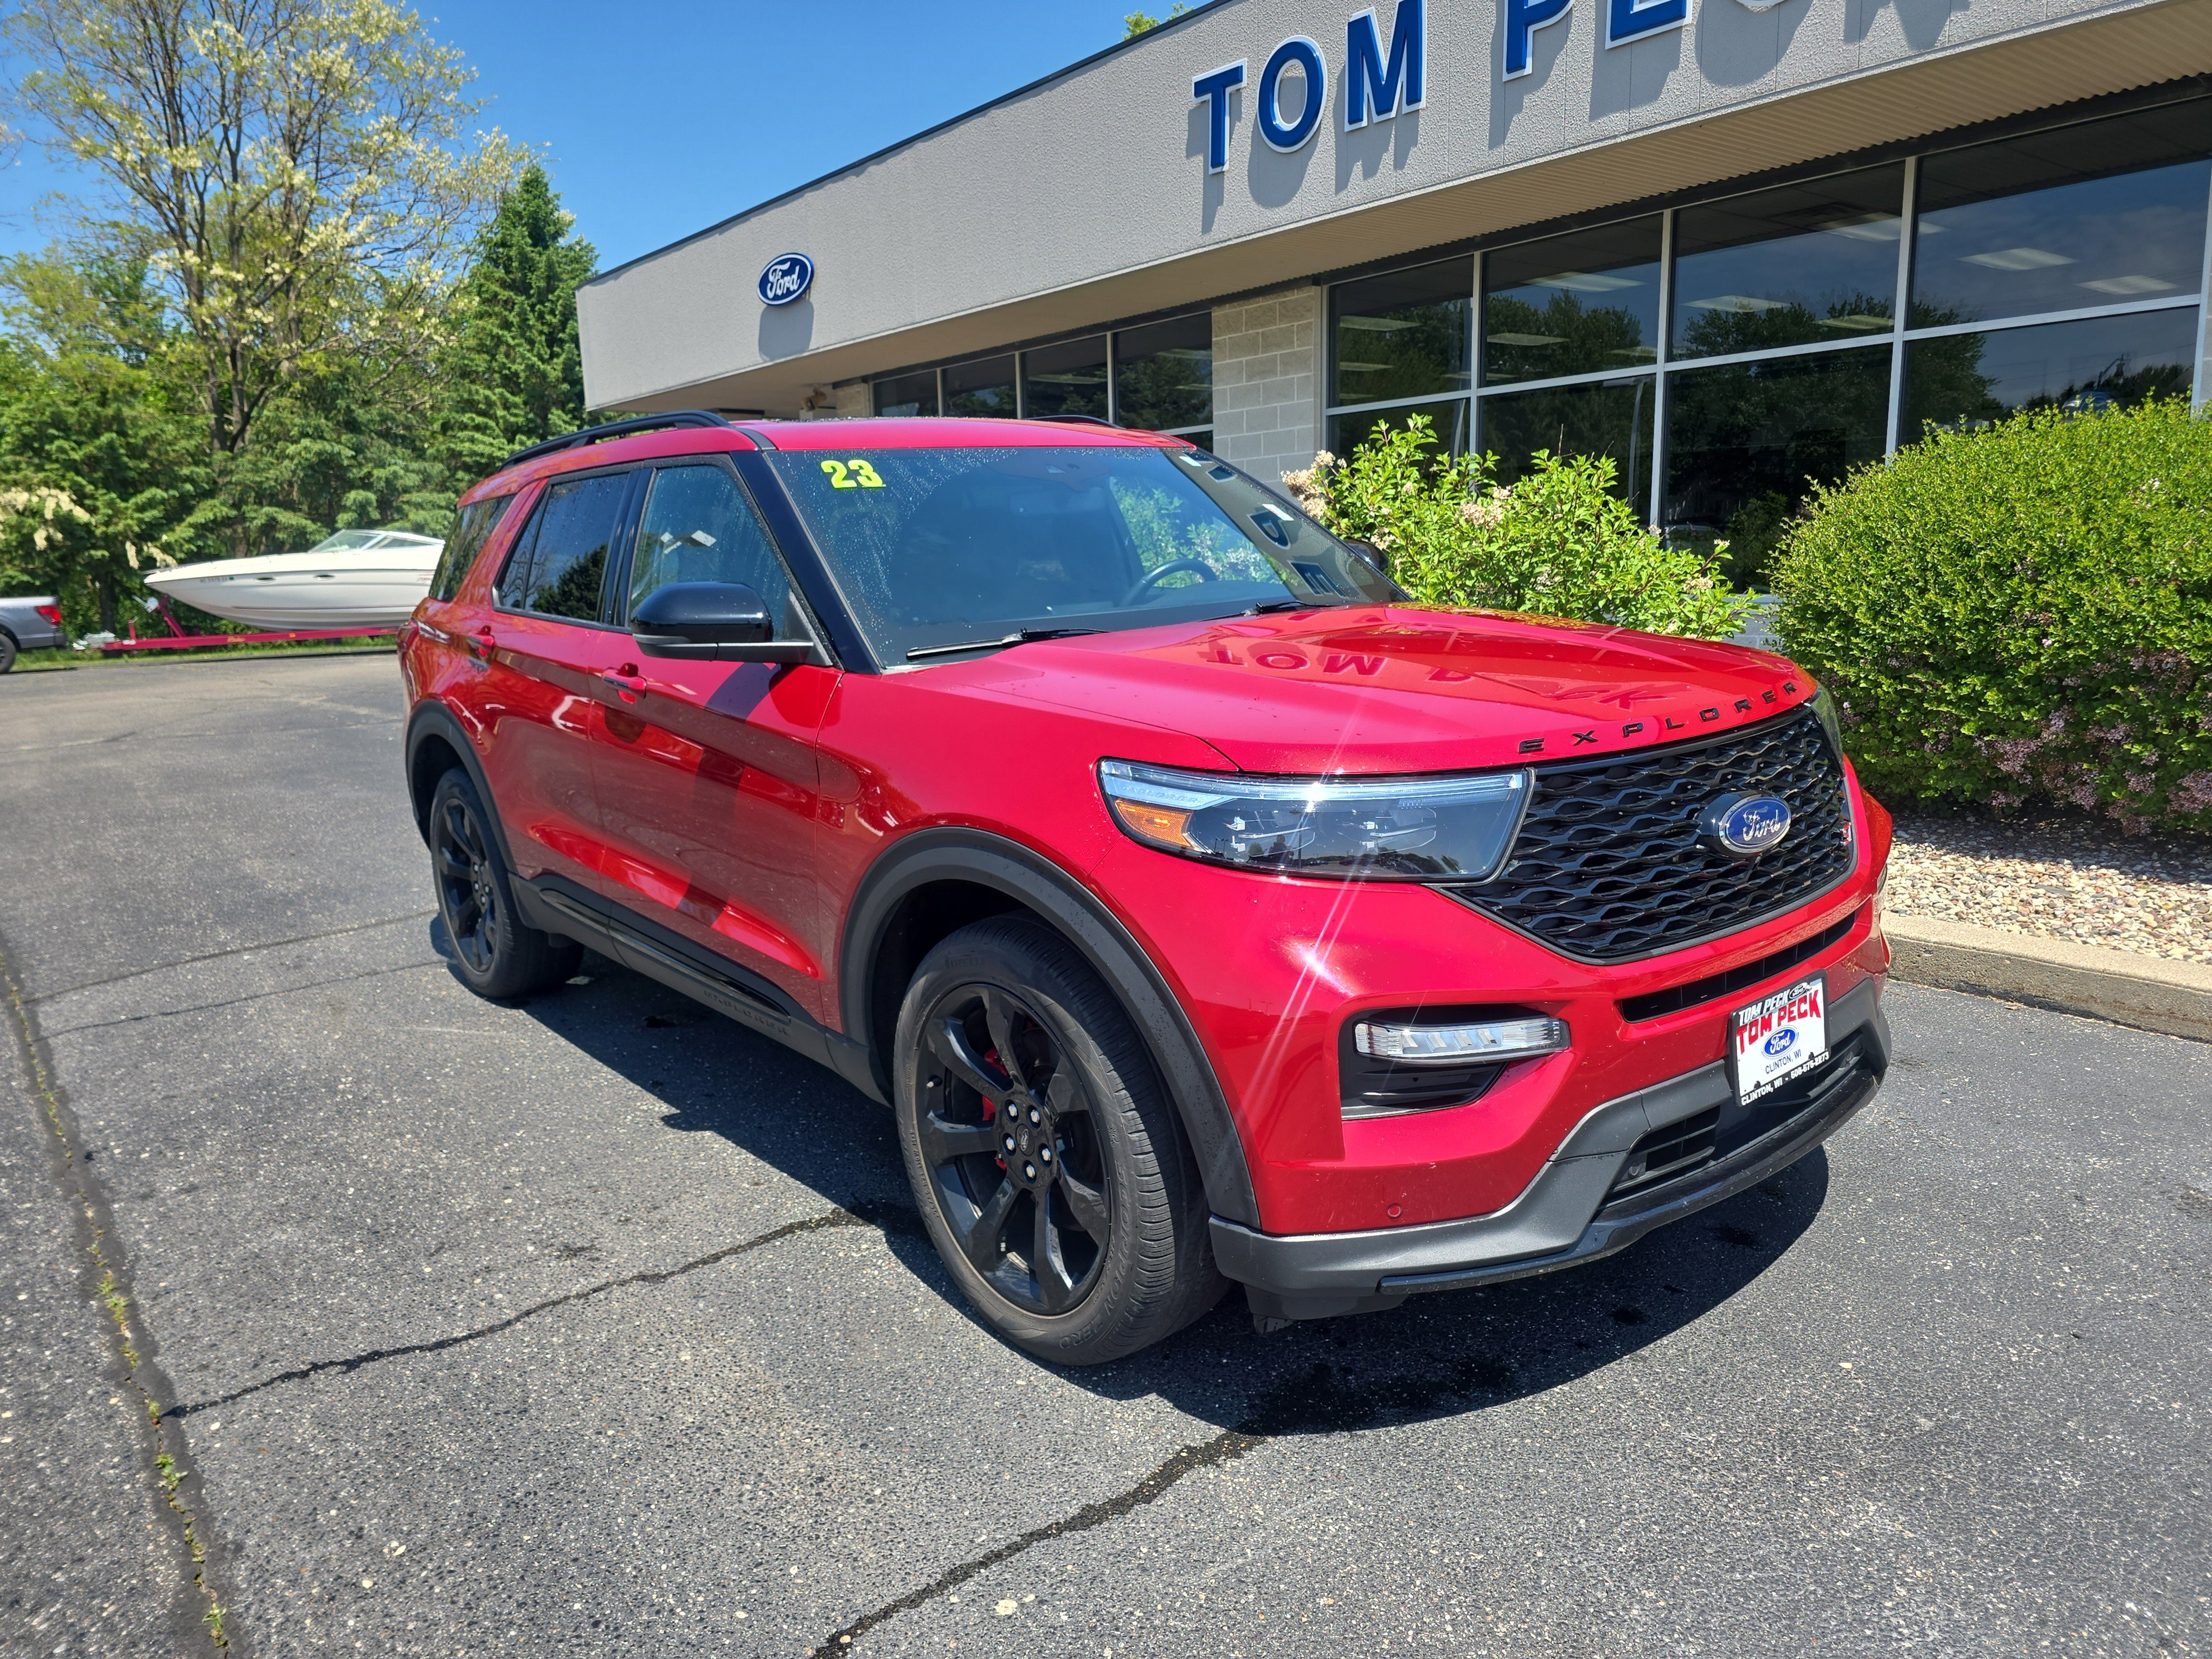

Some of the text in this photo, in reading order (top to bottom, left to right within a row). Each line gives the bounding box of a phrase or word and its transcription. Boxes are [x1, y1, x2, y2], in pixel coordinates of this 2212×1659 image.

[1193, 0, 1427, 175] TOM
[767, 261, 800, 299] Ford
[821, 459, 886, 488] 23
[1519, 681, 1798, 753] EXPLORER
[1742, 805, 1781, 840] Ford
[1736, 989, 1822, 1055] TOM PECK
[1738, 1002, 1762, 1026] TOM
[1763, 989, 1791, 1013] PECK
[1770, 1032, 1791, 1054] Ford
[1765, 1049, 1802, 1075] CLINTON, WI
[1741, 1082, 1774, 1106] CLINTON,
[1773, 1077, 1783, 1089] WI
[1104, 1159, 1130, 1316] SCORPION
